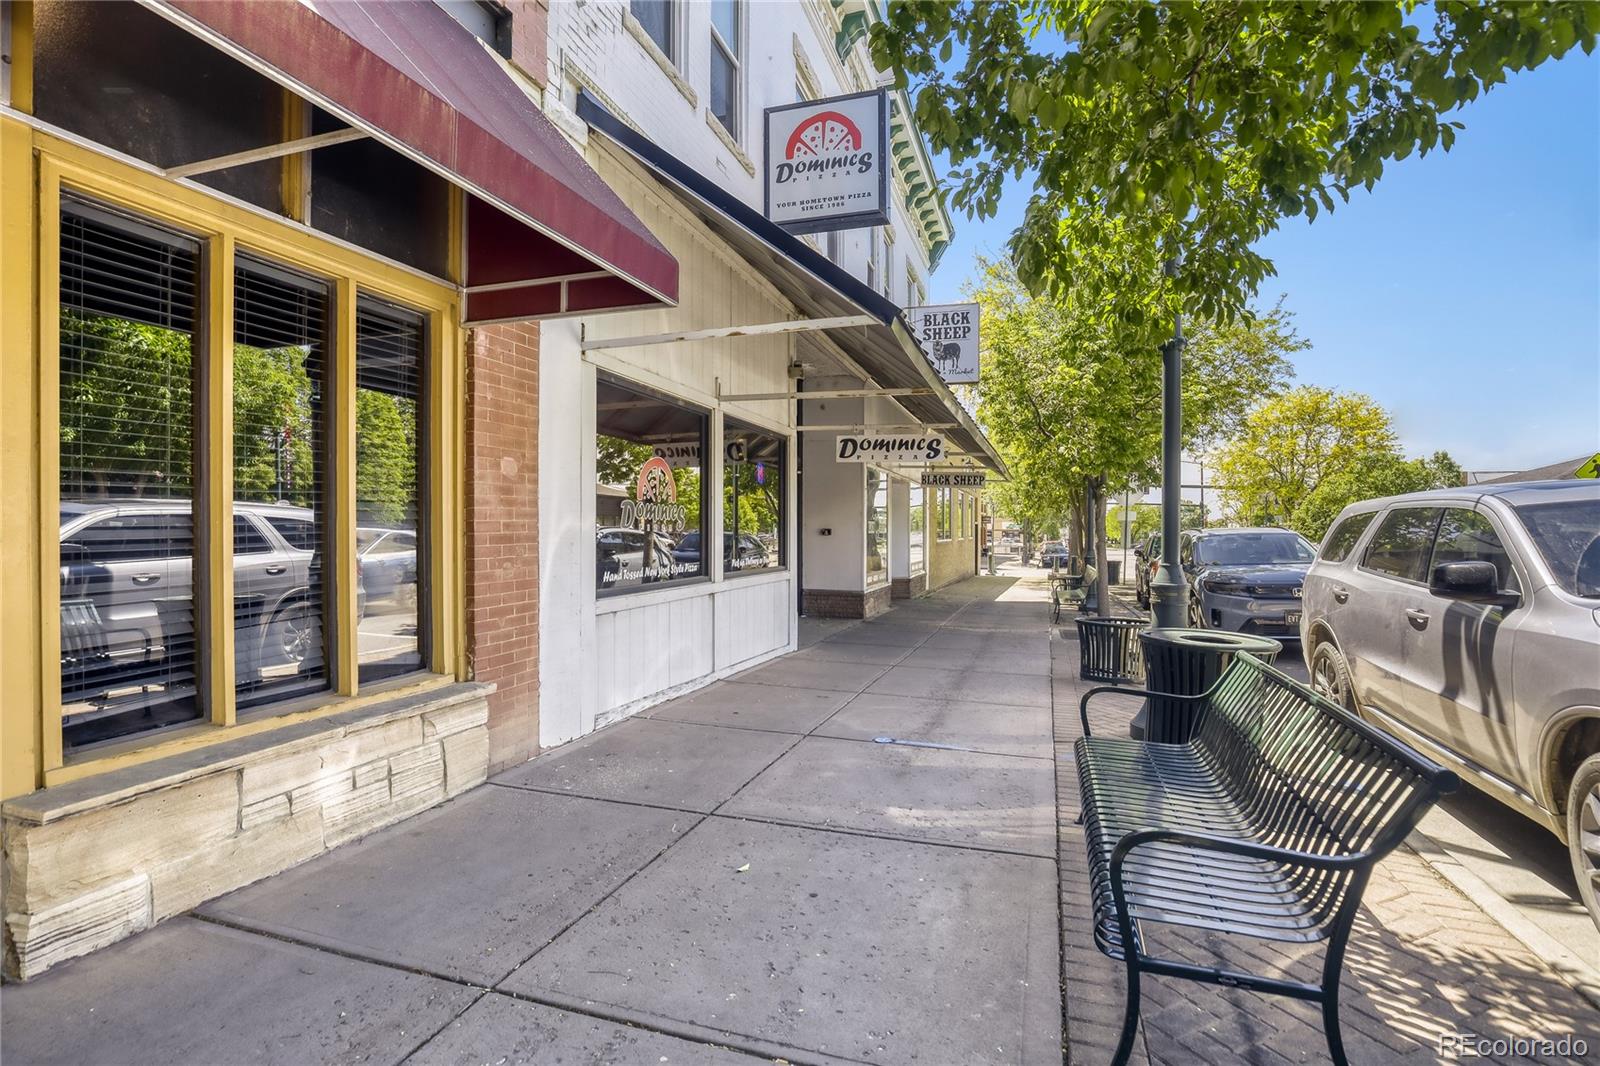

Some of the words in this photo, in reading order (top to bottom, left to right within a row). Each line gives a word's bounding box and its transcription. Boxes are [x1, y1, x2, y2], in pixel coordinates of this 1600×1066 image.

[792, 170, 851, 183] PIZZA
[776, 201, 797, 209] YOUR
[799, 195, 845, 205] HOMETOWN
[848, 191, 872, 200] PIZZA
[801, 203, 824, 212] SINCE
[923, 311, 971, 327] BLACK
[922, 326, 971, 341] SHEEP
[921, 473, 950, 486] BLACK
[953, 473, 985, 486] SHEEP
[602, 569, 623, 583] Hand
[623, 567, 644, 580] Tossed
[644, 566, 658, 577] New
